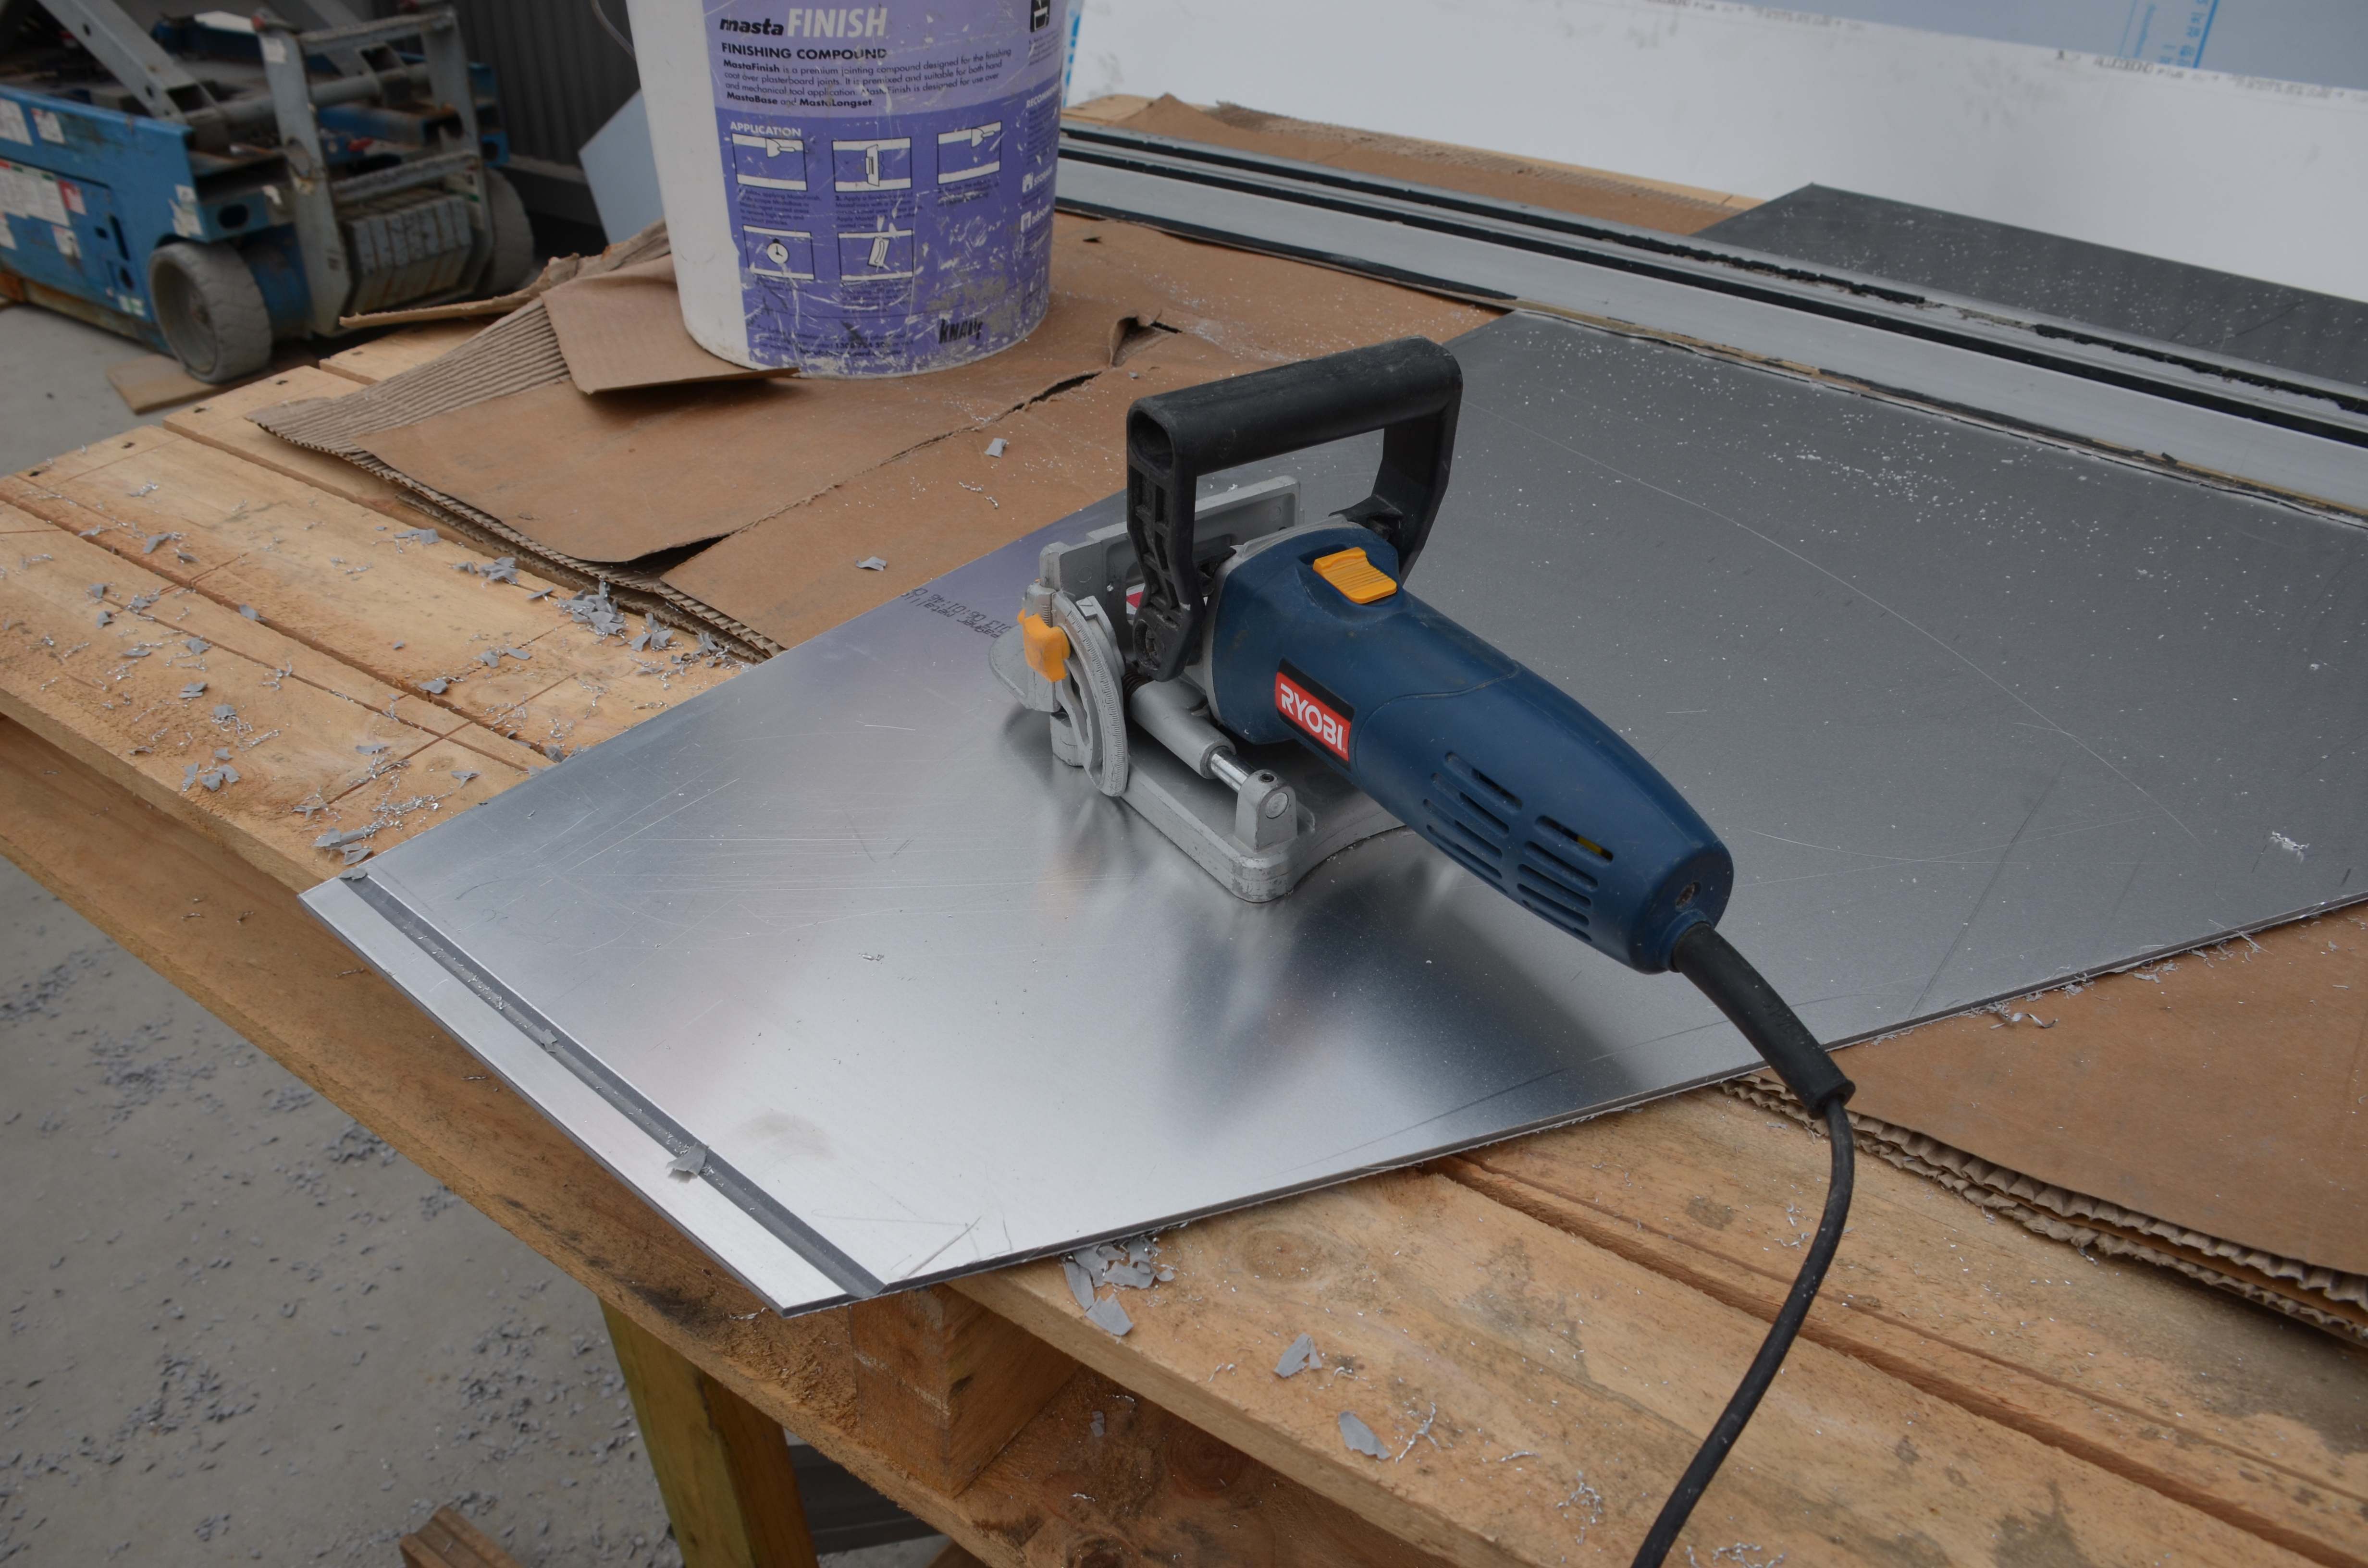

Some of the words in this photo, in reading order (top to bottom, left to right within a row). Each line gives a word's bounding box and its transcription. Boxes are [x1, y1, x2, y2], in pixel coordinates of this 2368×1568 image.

[719, 18, 784, 36] masta
[788, 8, 888, 37] FINISH
[722, 42, 791, 59] FINISHING
[797, 49, 887, 60] COMPOUND
[724, 60, 779, 73] MastaFinish
[801, 66, 838, 75] premium
[841, 66, 873, 76] jointing
[876, 61, 920, 74] compound
[924, 57, 958, 70] designed
[961, 56, 970, 64] for
[973, 54, 983, 62] the
[986, 49, 1011, 60] finishing
[726, 82, 740, 90] and
[742, 84, 787, 95] mechanical
[789, 87, 804, 95] tool
[807, 87, 857, 98] application.
[914, 83, 920, 92] is
[923, 78, 957, 91] designed
[985, 72, 999, 81] over
[762, 74, 814, 85] plasterboard
[817, 77, 842, 87] joints.
[863, 74, 902, 86] premixed
[905, 73, 921, 82] and
[924, 68, 953, 80] suitable
[969, 65, 983, 74] both
[986, 59, 1002, 70] hand
[727, 91, 777, 105] MastaBase
[1281, 683, 1344, 751] RYOBI
